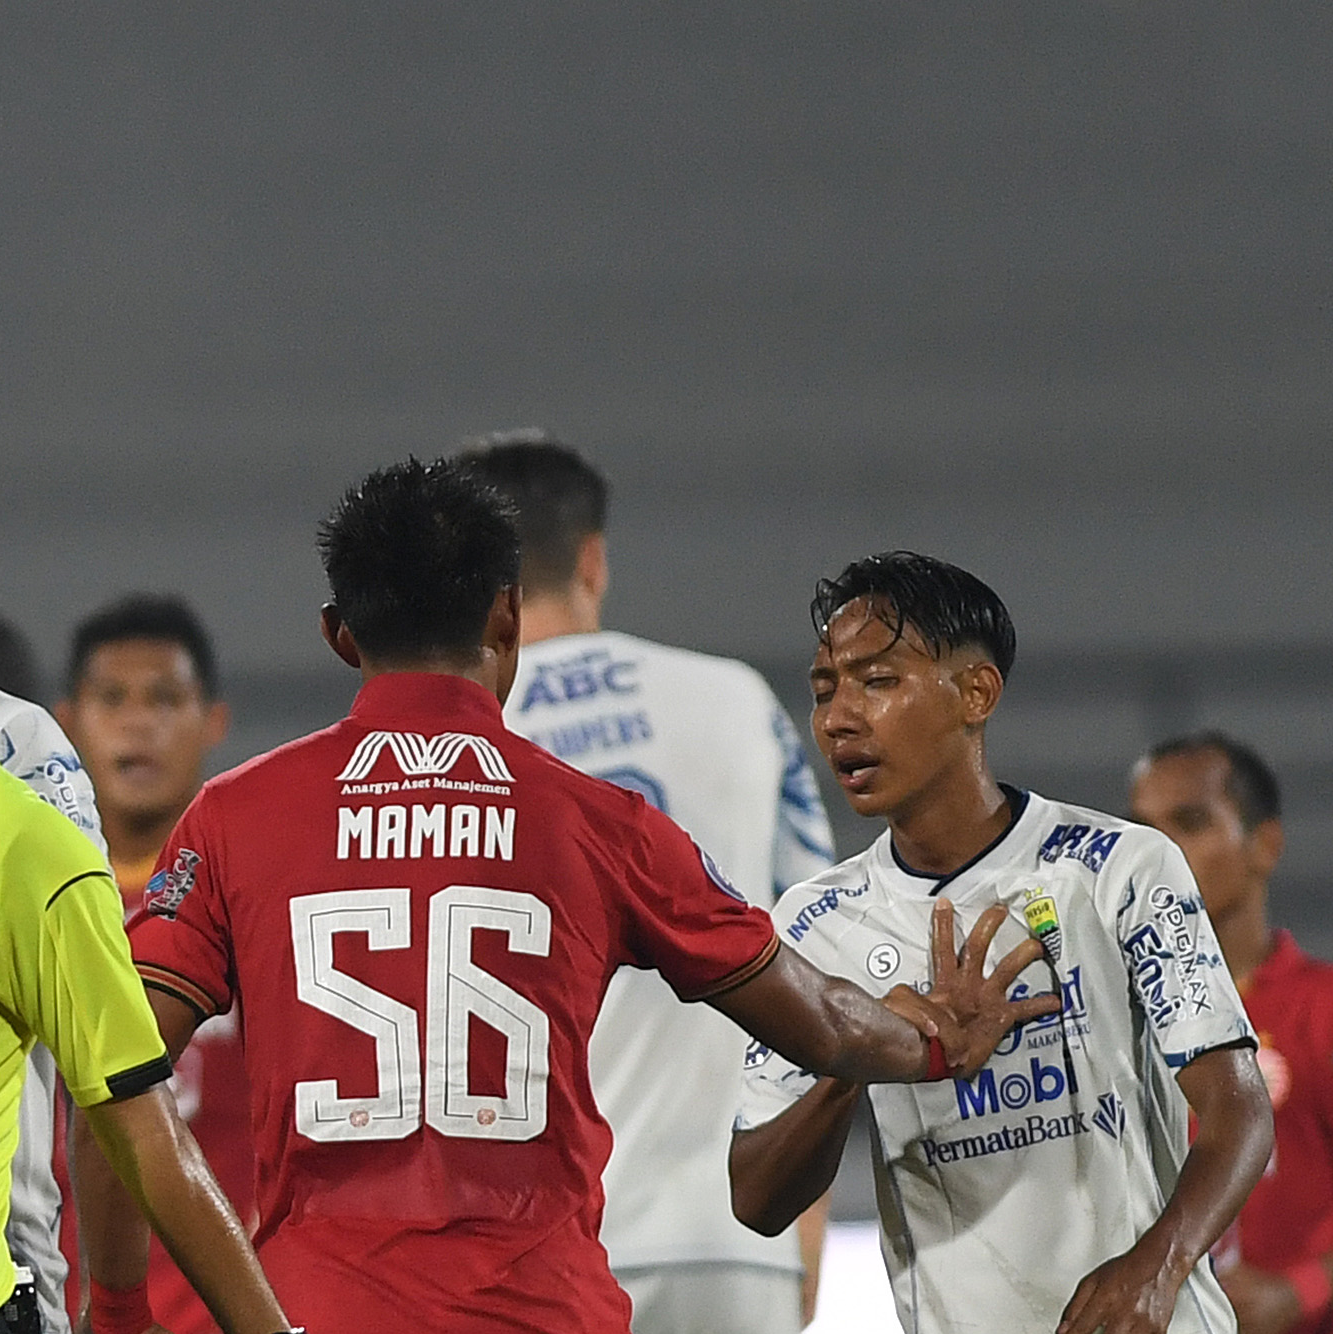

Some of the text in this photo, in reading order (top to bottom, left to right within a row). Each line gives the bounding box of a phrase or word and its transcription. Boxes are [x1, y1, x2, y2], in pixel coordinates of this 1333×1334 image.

[520, 661, 639, 713] ABC
[341, 776, 512, 797] Anargya Aset Manajemen
[337, 803, 517, 862] MAMAN
[1042, 824, 1122, 864] ARIA
[289, 885, 552, 1142] 56
[921, 1112, 1091, 1167] PermataBank
